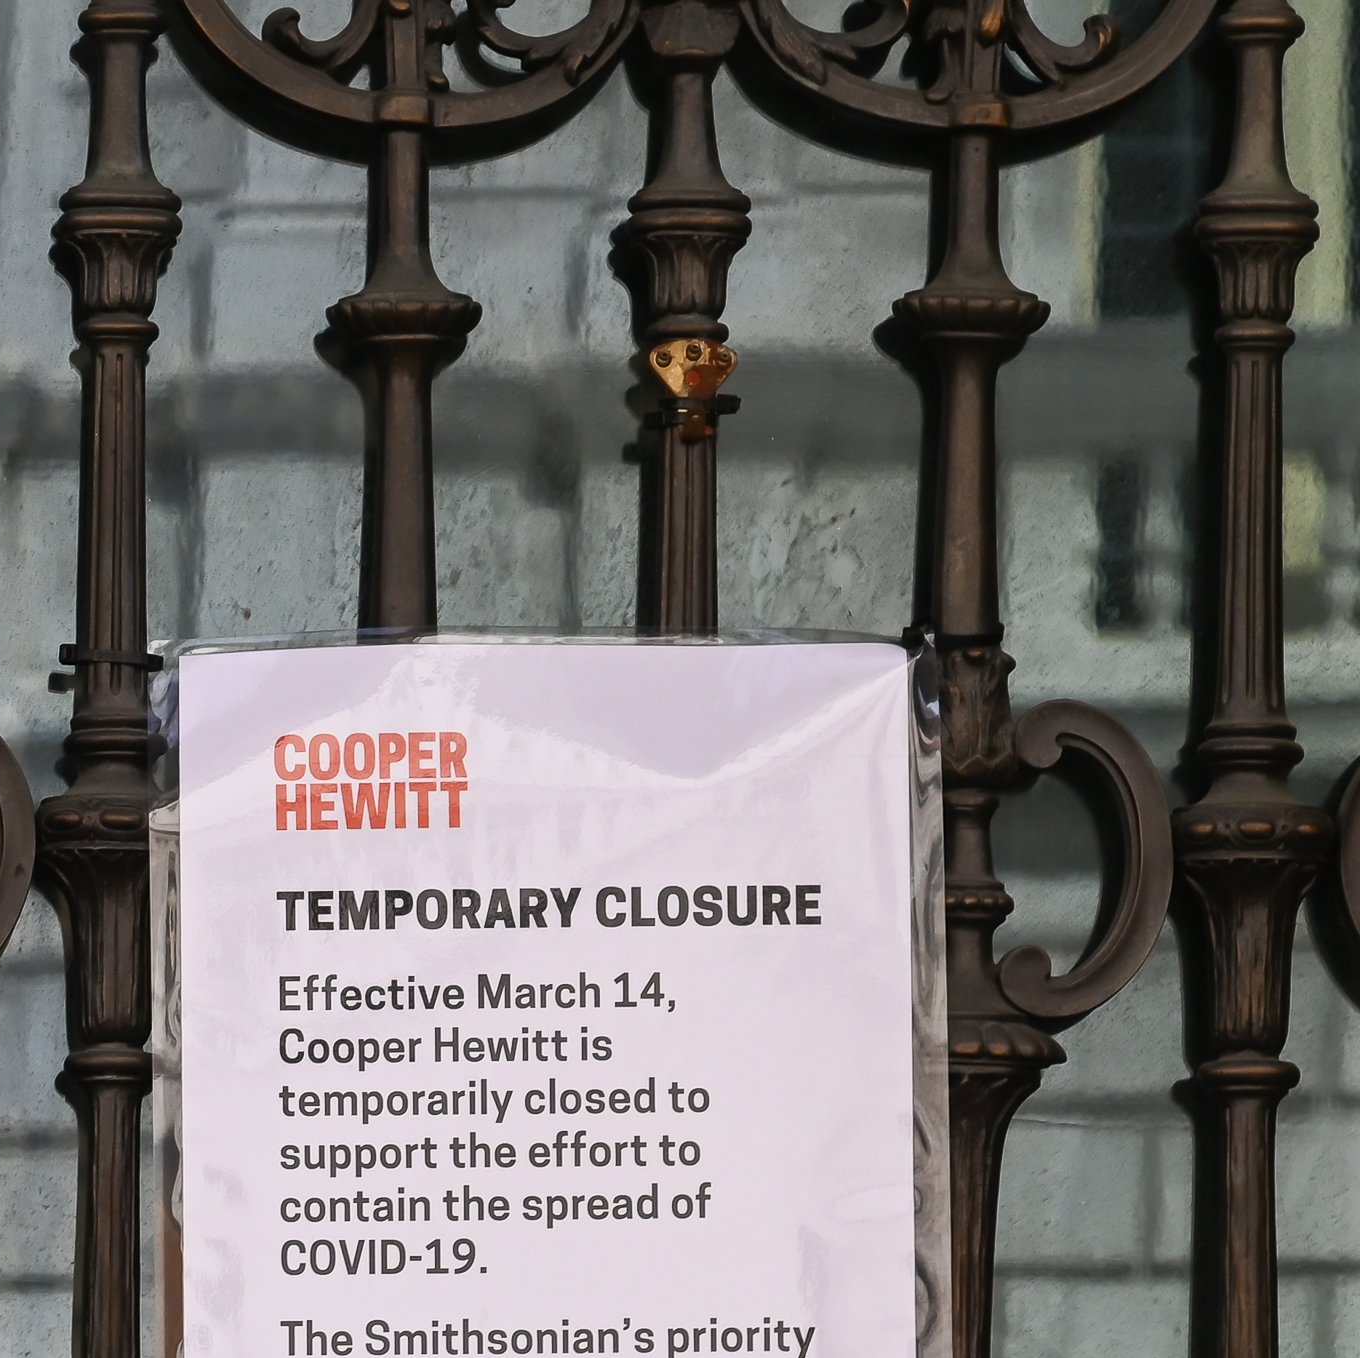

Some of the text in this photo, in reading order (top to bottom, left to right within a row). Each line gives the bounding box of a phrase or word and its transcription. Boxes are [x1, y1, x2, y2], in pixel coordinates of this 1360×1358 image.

[274, 732, 467, 781] COOPER
[276, 781, 468, 831] HEWITT
[277, 885, 821, 931] TEMPORARY CLOSURE
[279, 972, 675, 1012] Effective March 14,
[279, 1027, 612, 1071] Cooper Hewitt is
[279, 1077, 709, 1124] temporarily closed to
[280, 1130, 700, 1178] support the effort to
[280, 1182, 711, 1229] contain the spread of
[281, 1238, 487, 1275] COVID-19.
[280, 1320, 353, 1356] The
[366, 1318, 654, 1355] Smithsonian’s
